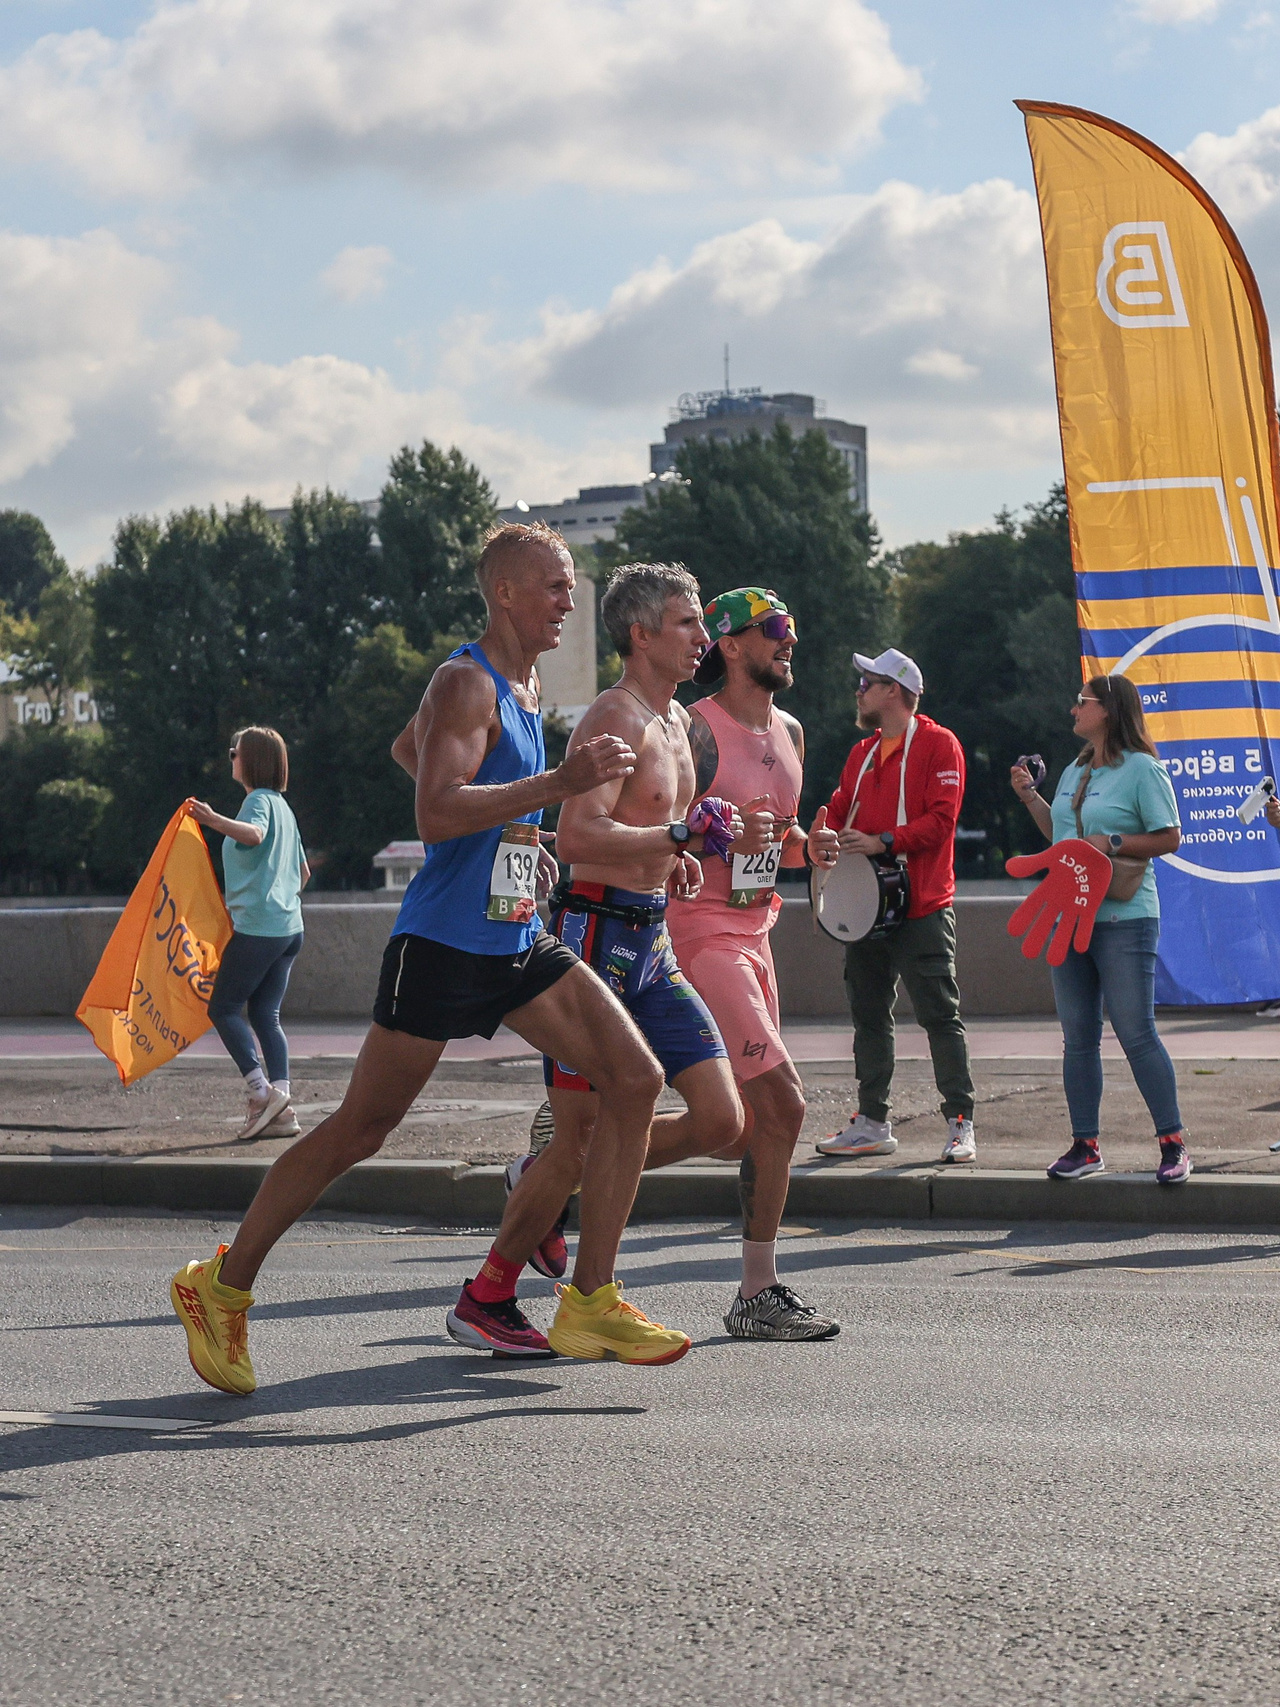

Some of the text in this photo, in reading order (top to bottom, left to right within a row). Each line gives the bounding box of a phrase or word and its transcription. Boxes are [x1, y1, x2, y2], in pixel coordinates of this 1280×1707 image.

[503, 850, 537, 882] 139
[742, 848, 781, 875] 226
[1059, 854, 1090, 907] 5 вёрст
